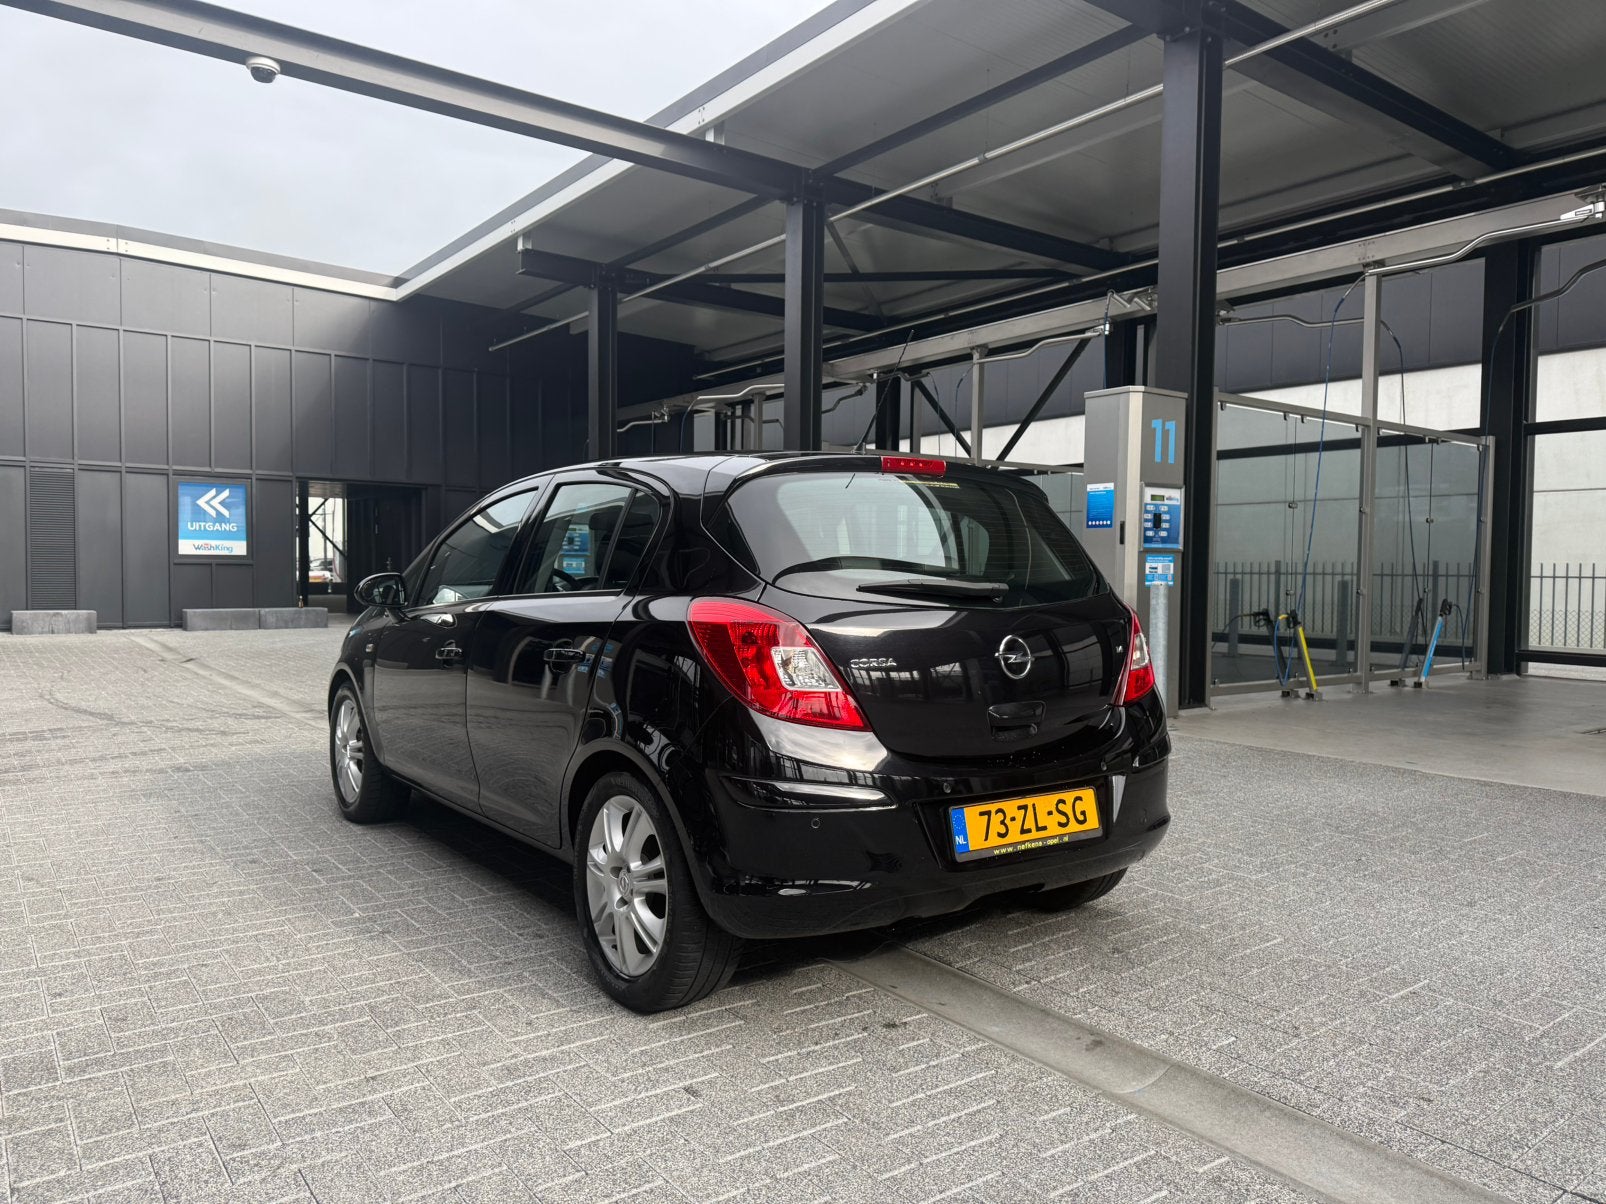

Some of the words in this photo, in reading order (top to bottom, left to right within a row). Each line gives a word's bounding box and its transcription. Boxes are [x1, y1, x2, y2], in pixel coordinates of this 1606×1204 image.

[1151, 419, 1176, 464] 11
[187, 521, 238, 532] UITGANG
[193, 543, 234, 553] WashKing
[850, 657, 897, 668] CORSA
[978, 795, 1088, 842] 73-ZL-SG
[955, 835, 967, 845] NL
